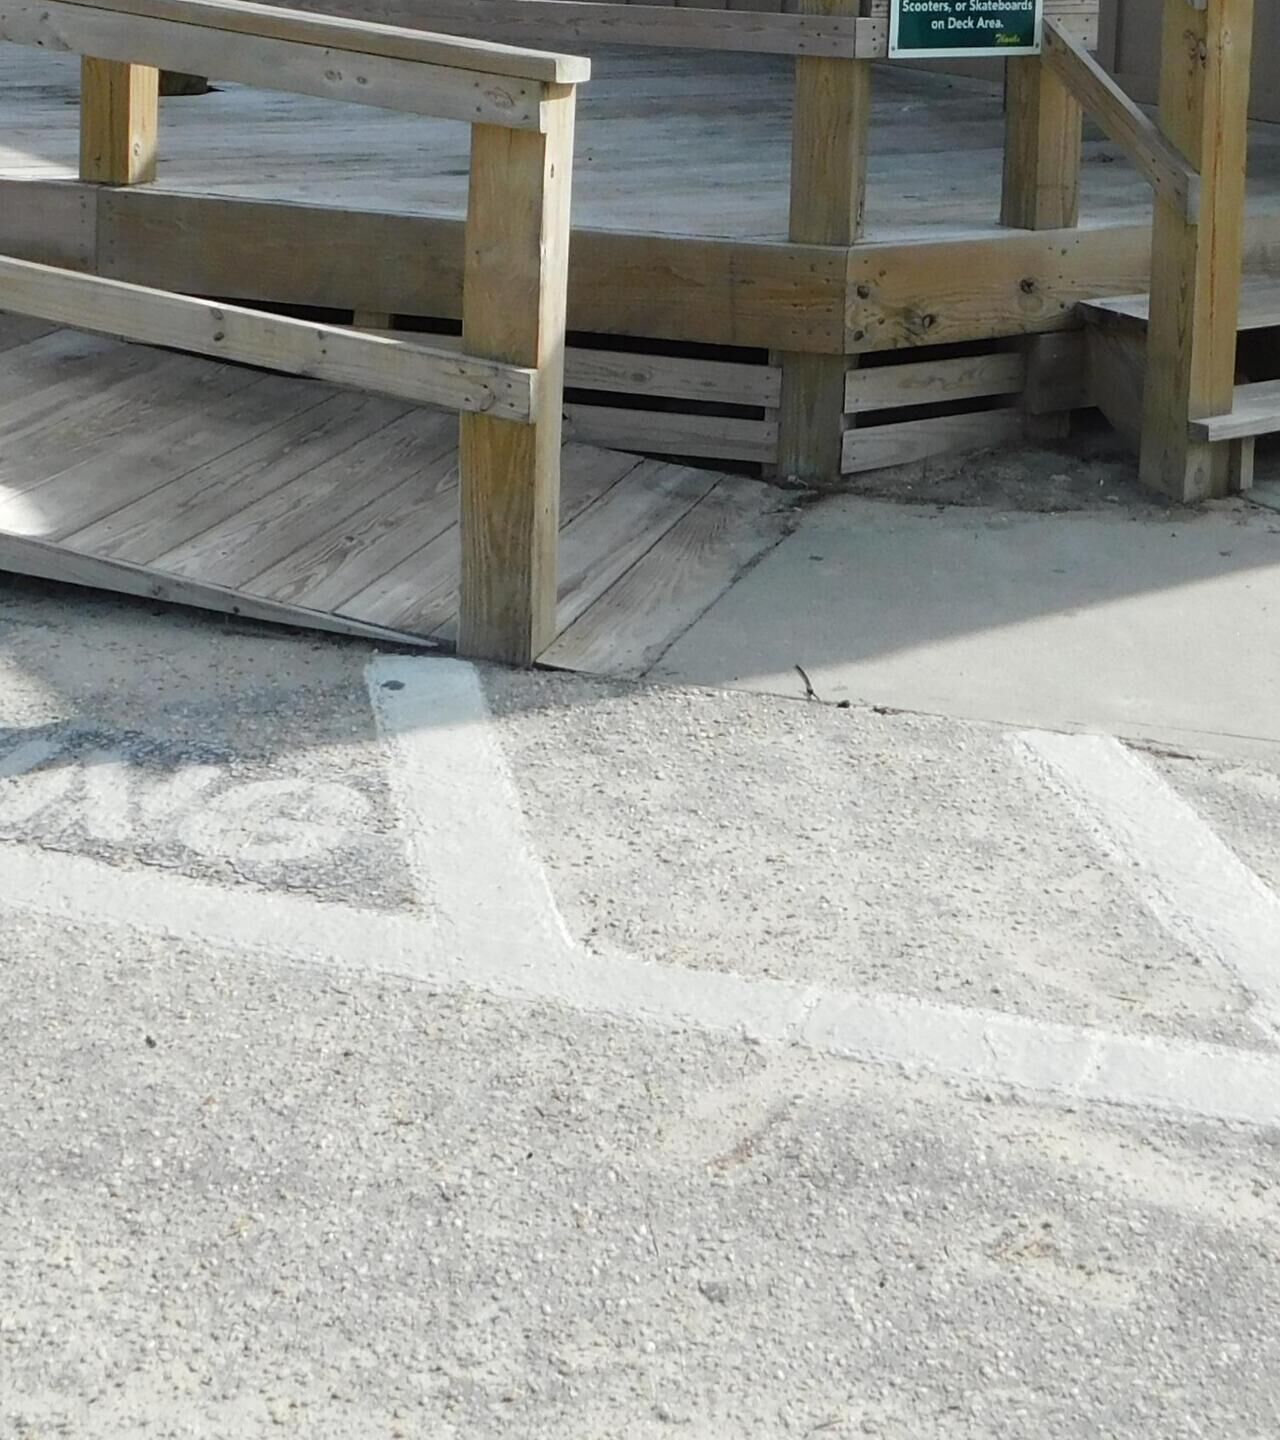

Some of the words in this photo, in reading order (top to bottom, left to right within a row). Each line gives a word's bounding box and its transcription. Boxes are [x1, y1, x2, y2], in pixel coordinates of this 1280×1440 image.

[902, 0, 952, 13] Scooters,
[955, 2, 967, 11] or
[931, 20, 945, 29] on
[948, 16, 974, 29] Deck
[976, 17, 1004, 29] Area.
